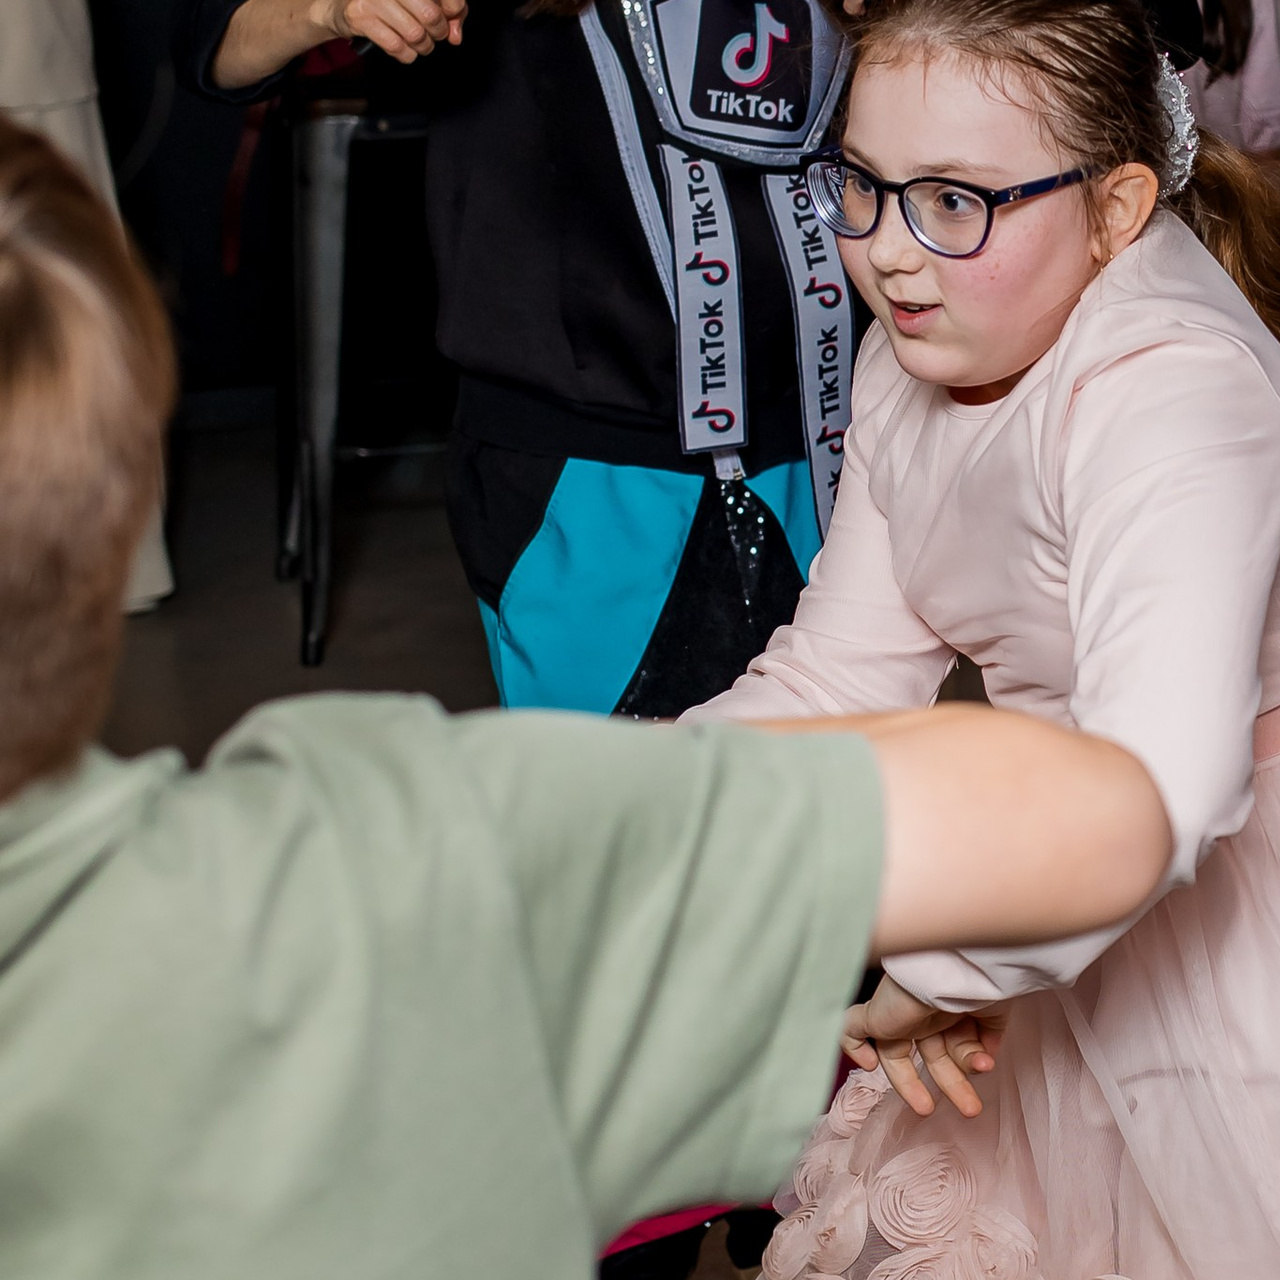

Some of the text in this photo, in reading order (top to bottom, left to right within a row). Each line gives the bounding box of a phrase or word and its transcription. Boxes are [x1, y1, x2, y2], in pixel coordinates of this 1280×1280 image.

[707, 89, 794, 123] TikTok
[698, 298, 727, 395] TikTok
[817, 324, 840, 421] TikTok
